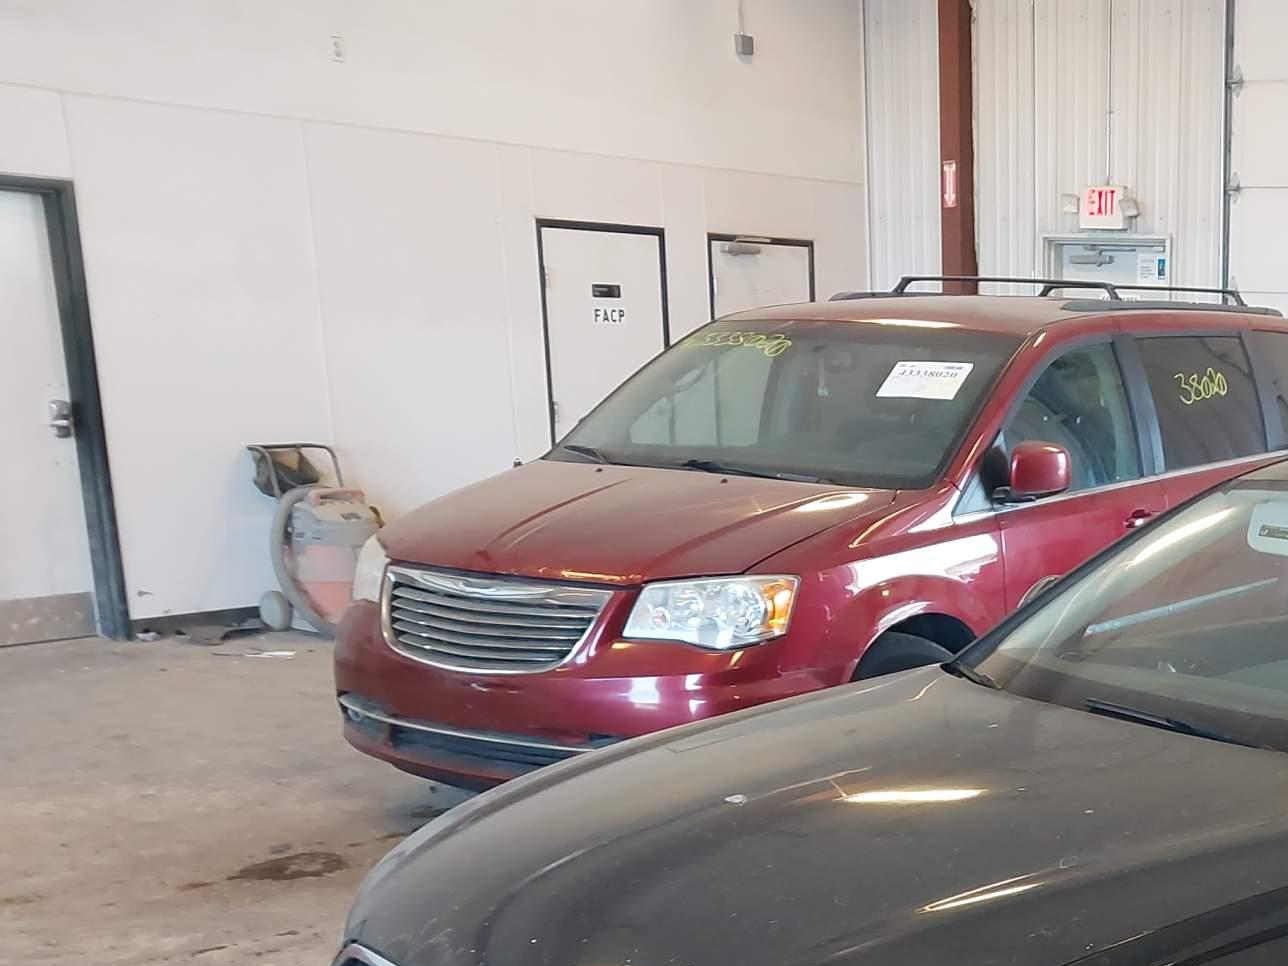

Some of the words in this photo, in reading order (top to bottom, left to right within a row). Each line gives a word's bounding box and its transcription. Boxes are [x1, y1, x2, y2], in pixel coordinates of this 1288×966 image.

[1088, 189, 1116, 216] EXIT
[593, 308, 625, 323] FACP
[1173, 367, 1228, 405] 38020
